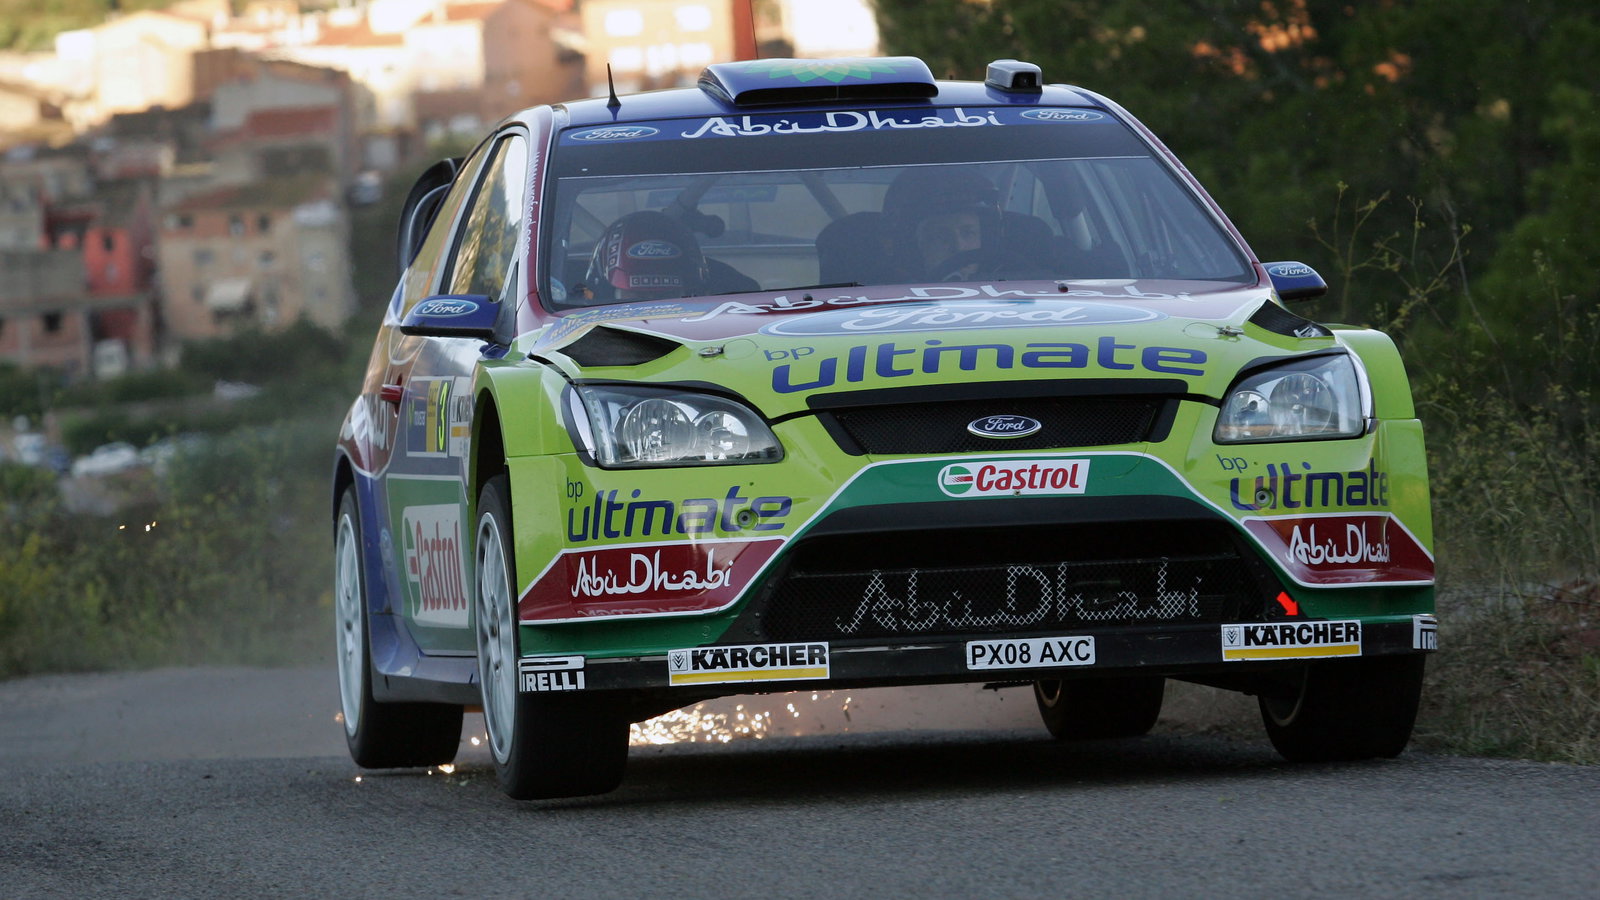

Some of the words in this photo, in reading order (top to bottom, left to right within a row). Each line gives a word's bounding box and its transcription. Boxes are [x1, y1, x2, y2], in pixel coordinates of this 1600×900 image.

[1037, 110, 1089, 121] Ford
[586, 127, 643, 140] Ford
[637, 243, 672, 256] Ford
[1279, 265, 1311, 276] Ford
[422, 301, 467, 315] Ford
[841, 301, 1088, 330] Ford
[764, 346, 815, 361] bp
[772, 336, 1207, 394] ultimate
[437, 382, 448, 451] 3
[984, 417, 1025, 431] Ford
[1216, 454, 1248, 473] bp
[566, 477, 583, 502] bp
[976, 463, 1079, 492] Castrol
[1230, 457, 1388, 511] ultimate
[568, 486, 793, 542] ultimate
[416, 520, 467, 611] Castrol
[1244, 622, 1359, 647] KÄRCHER
[692, 645, 827, 671] KÄRCHER
[971, 642, 1032, 666] PX08
[1039, 639, 1092, 663] AXC
